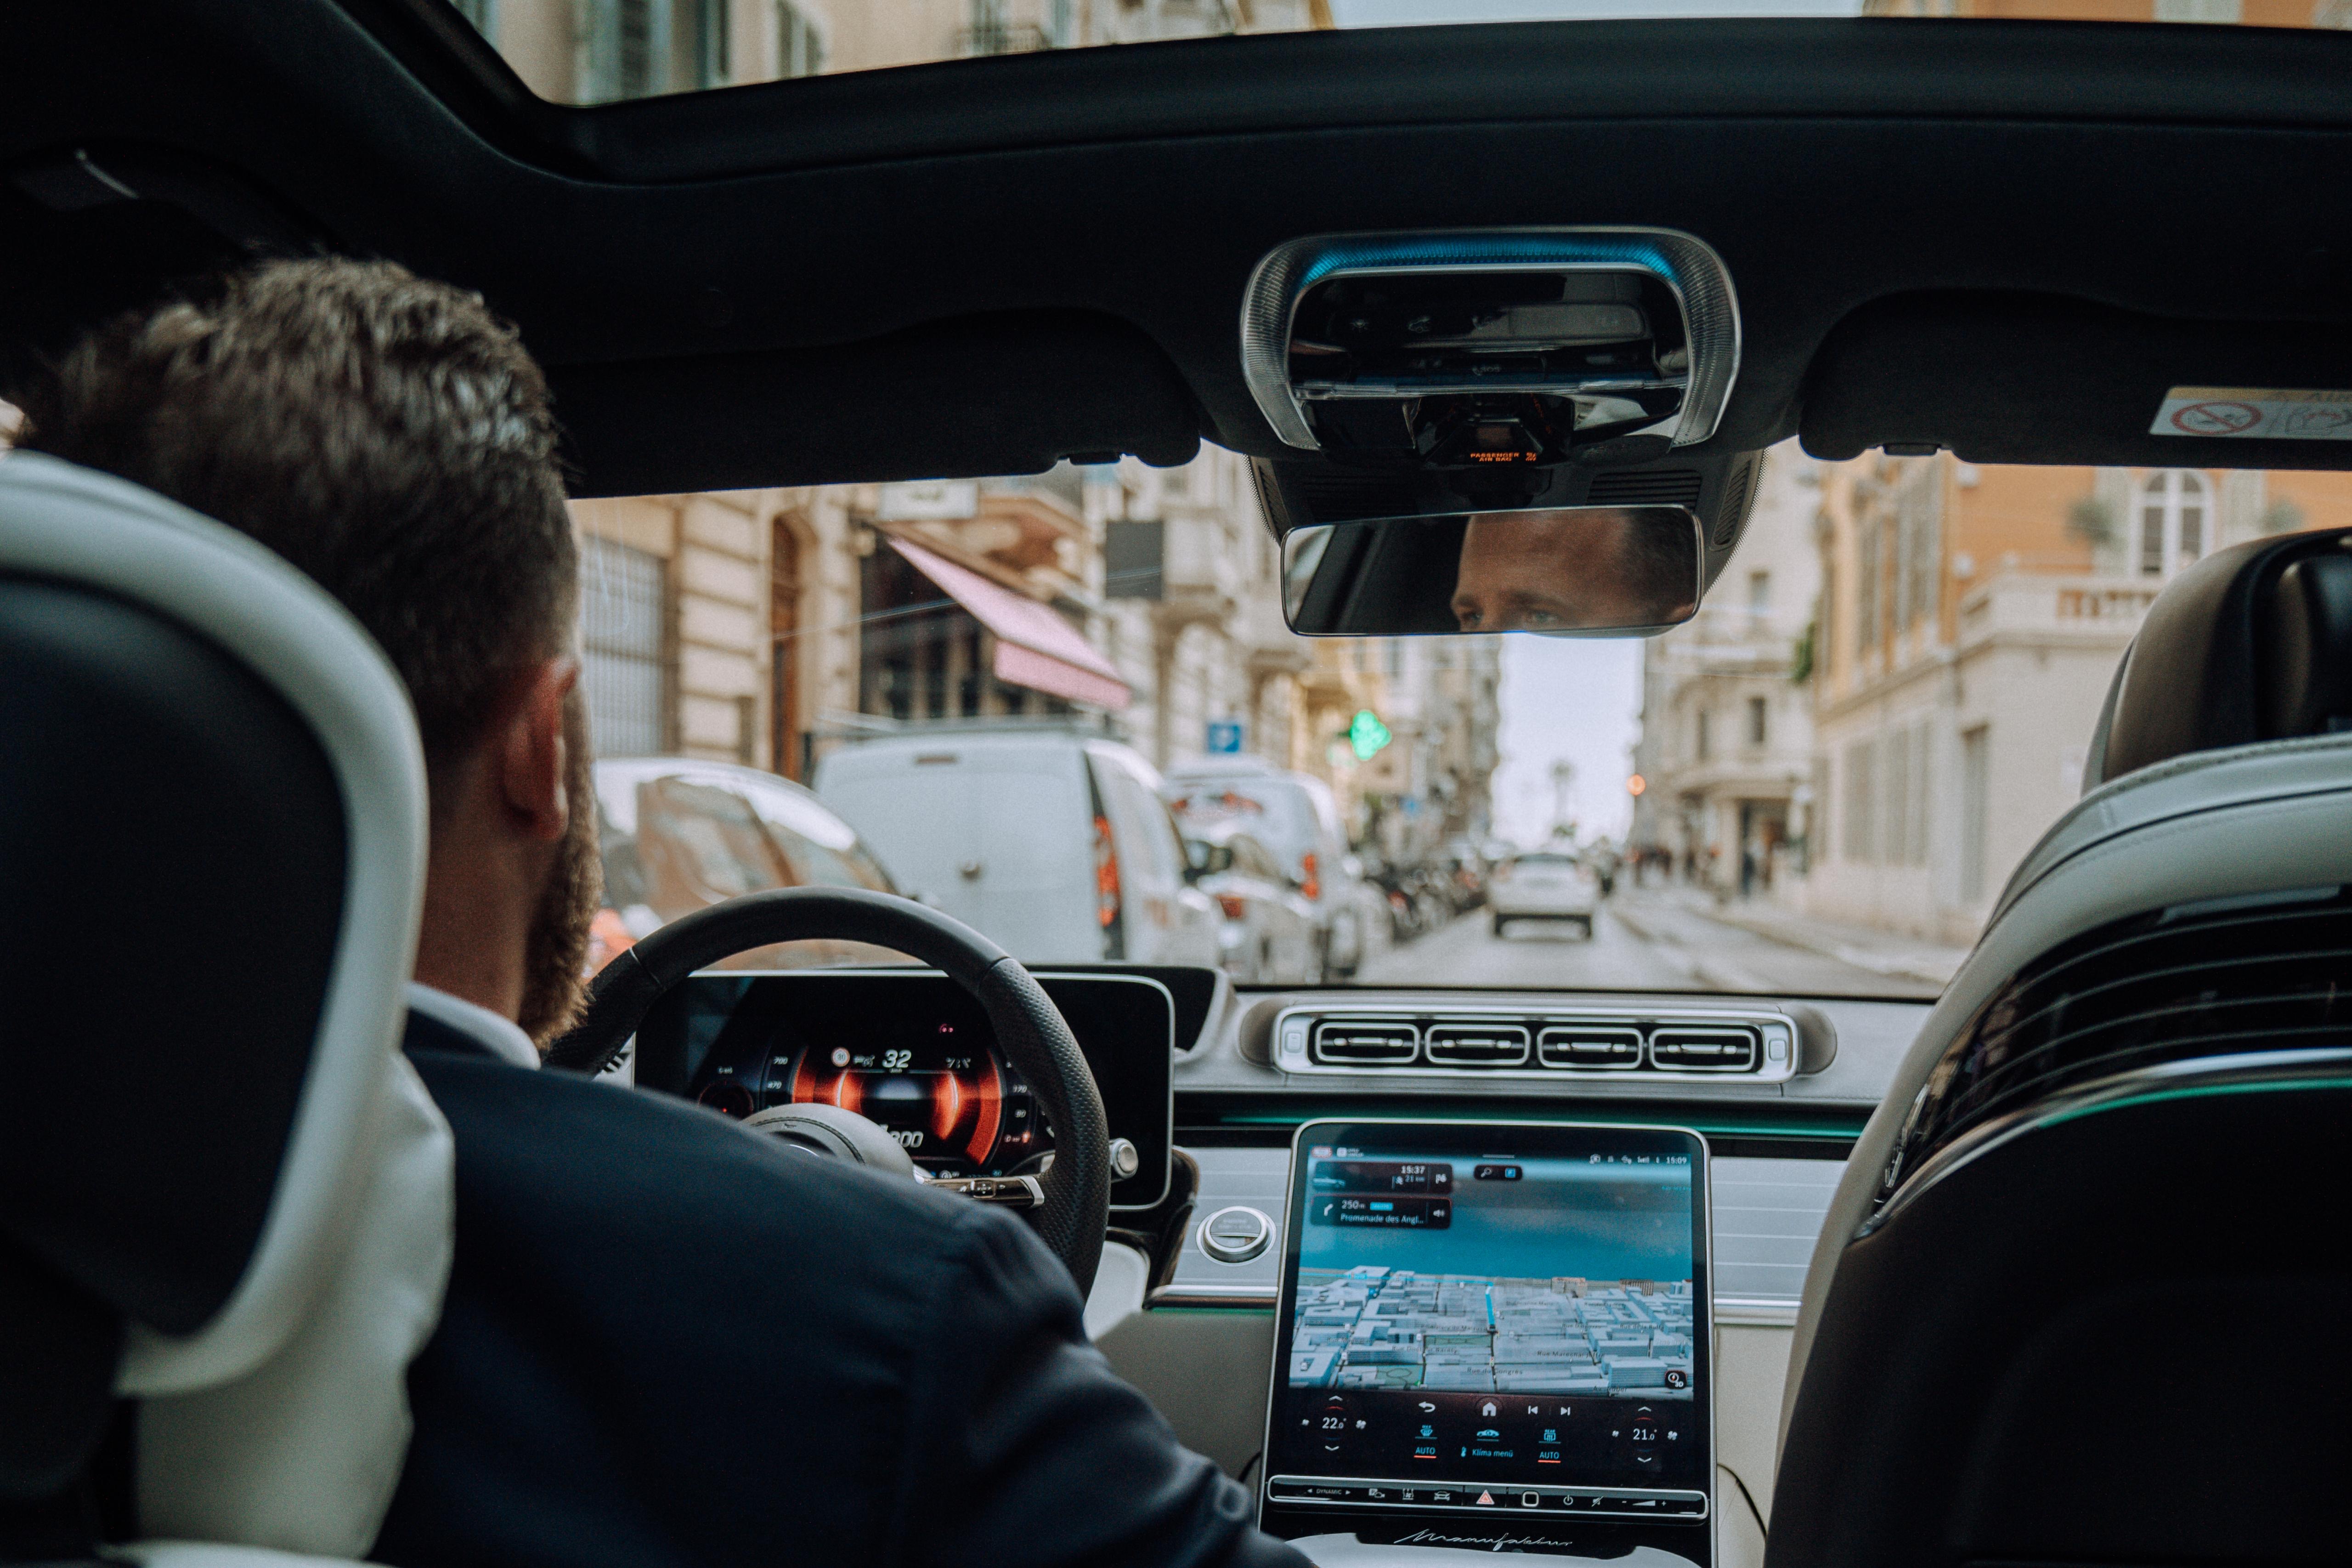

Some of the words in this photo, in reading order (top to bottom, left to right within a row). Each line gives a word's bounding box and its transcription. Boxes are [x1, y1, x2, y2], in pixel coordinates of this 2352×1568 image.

[881, 1048, 912, 1068] 32
[1340, 1213, 1384, 1223] Promenade
[1385, 1214, 1400, 1223] des
[1467, 1367, 1481, 1375] Rue
[1415, 1446, 1436, 1455] AUTO
[1539, 1451, 1560, 1460] AUTO
